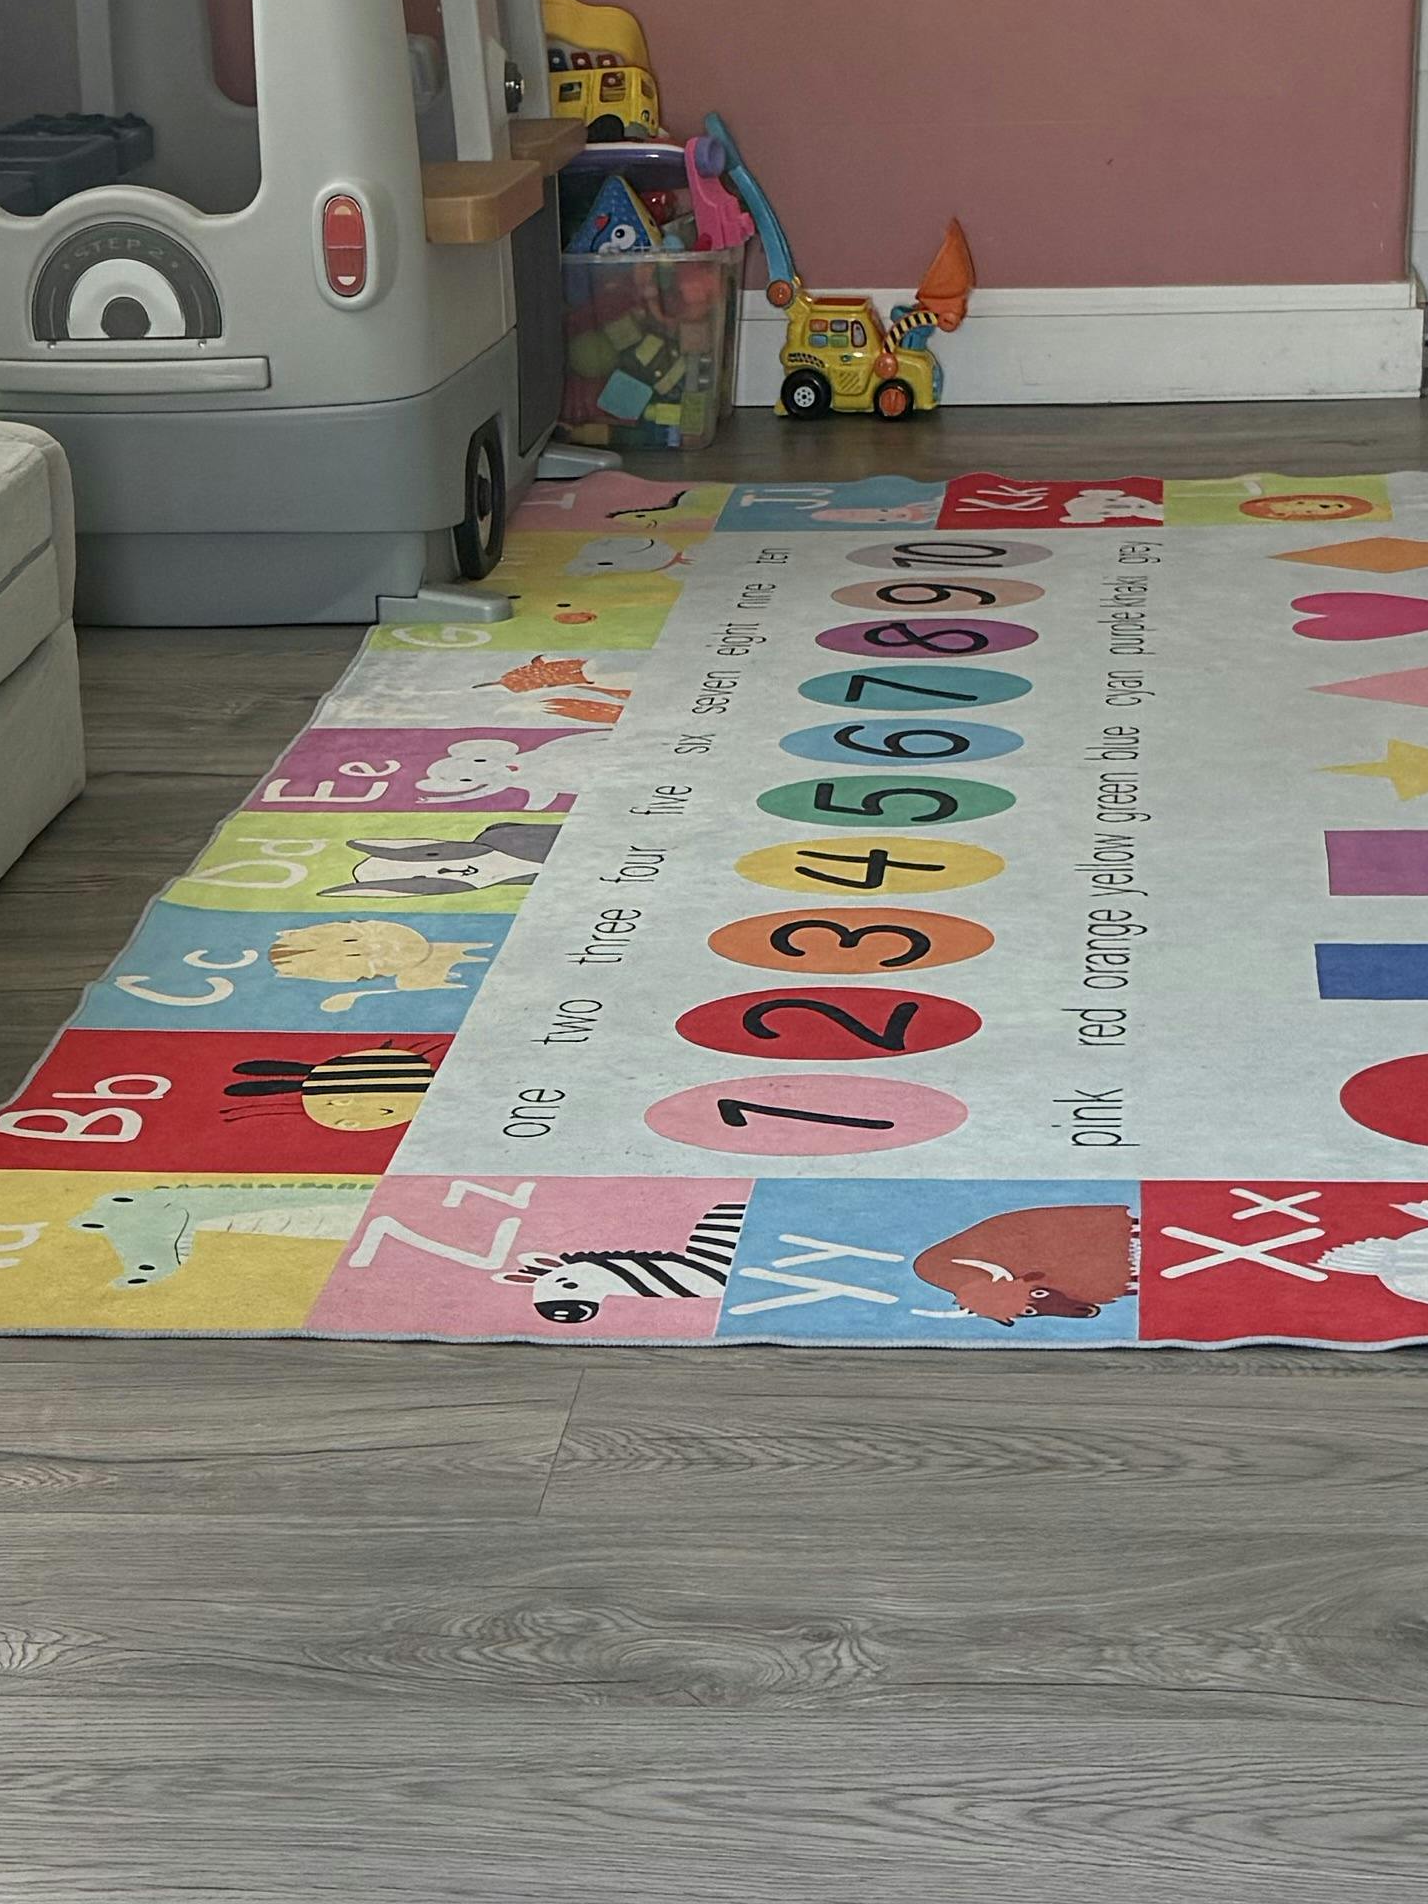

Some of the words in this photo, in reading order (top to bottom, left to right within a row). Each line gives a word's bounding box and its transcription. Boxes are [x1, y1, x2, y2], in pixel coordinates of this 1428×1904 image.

[955, 484, 1049, 513] Kk
[749, 547, 792, 564] ten
[892, 542, 1006, 568] 10
[1117, 541, 1163, 564] grey
[737, 583, 776, 609] nine
[876, 583, 996, 605] 9
[1100, 576, 1148, 610] khaki
[705, 622, 767, 657] eight
[864, 622, 989, 654] 8
[1098, 611, 1157, 656] purple
[692, 669, 741, 715] seven
[844, 674, 979, 702] 7
[1105, 670, 1155, 707] cyan
[662, 733, 716, 755] six
[834, 725, 970, 759] 6
[1084, 726, 1139, 761] blue
[262, 759, 402, 803] Ee
[629, 785, 692, 816] five
[1097, 771, 1150, 822] green
[813, 783, 958, 822] 5
[187, 838, 327, 889] Dd
[600, 845, 668, 884] four
[795, 849, 945, 889] 4
[1074, 832, 1148, 897] yellow
[566, 908, 641, 965] three
[770, 920, 931, 967] 3
[1084, 908, 1146, 989] orange
[115, 948, 259, 1007] Cc
[531, 999, 603, 1046] two
[743, 999, 919, 1051] 2
[1062, 1008, 1126, 1046] red
[503, 1087, 565, 1138] one
[717, 1099, 894, 1129] 1
[1051, 1088, 1139, 1147] pink
[348, 1182, 537, 1270] Zz
[1161, 1188, 1328, 1282] Xx
[729, 1234, 904, 1316] Yy
